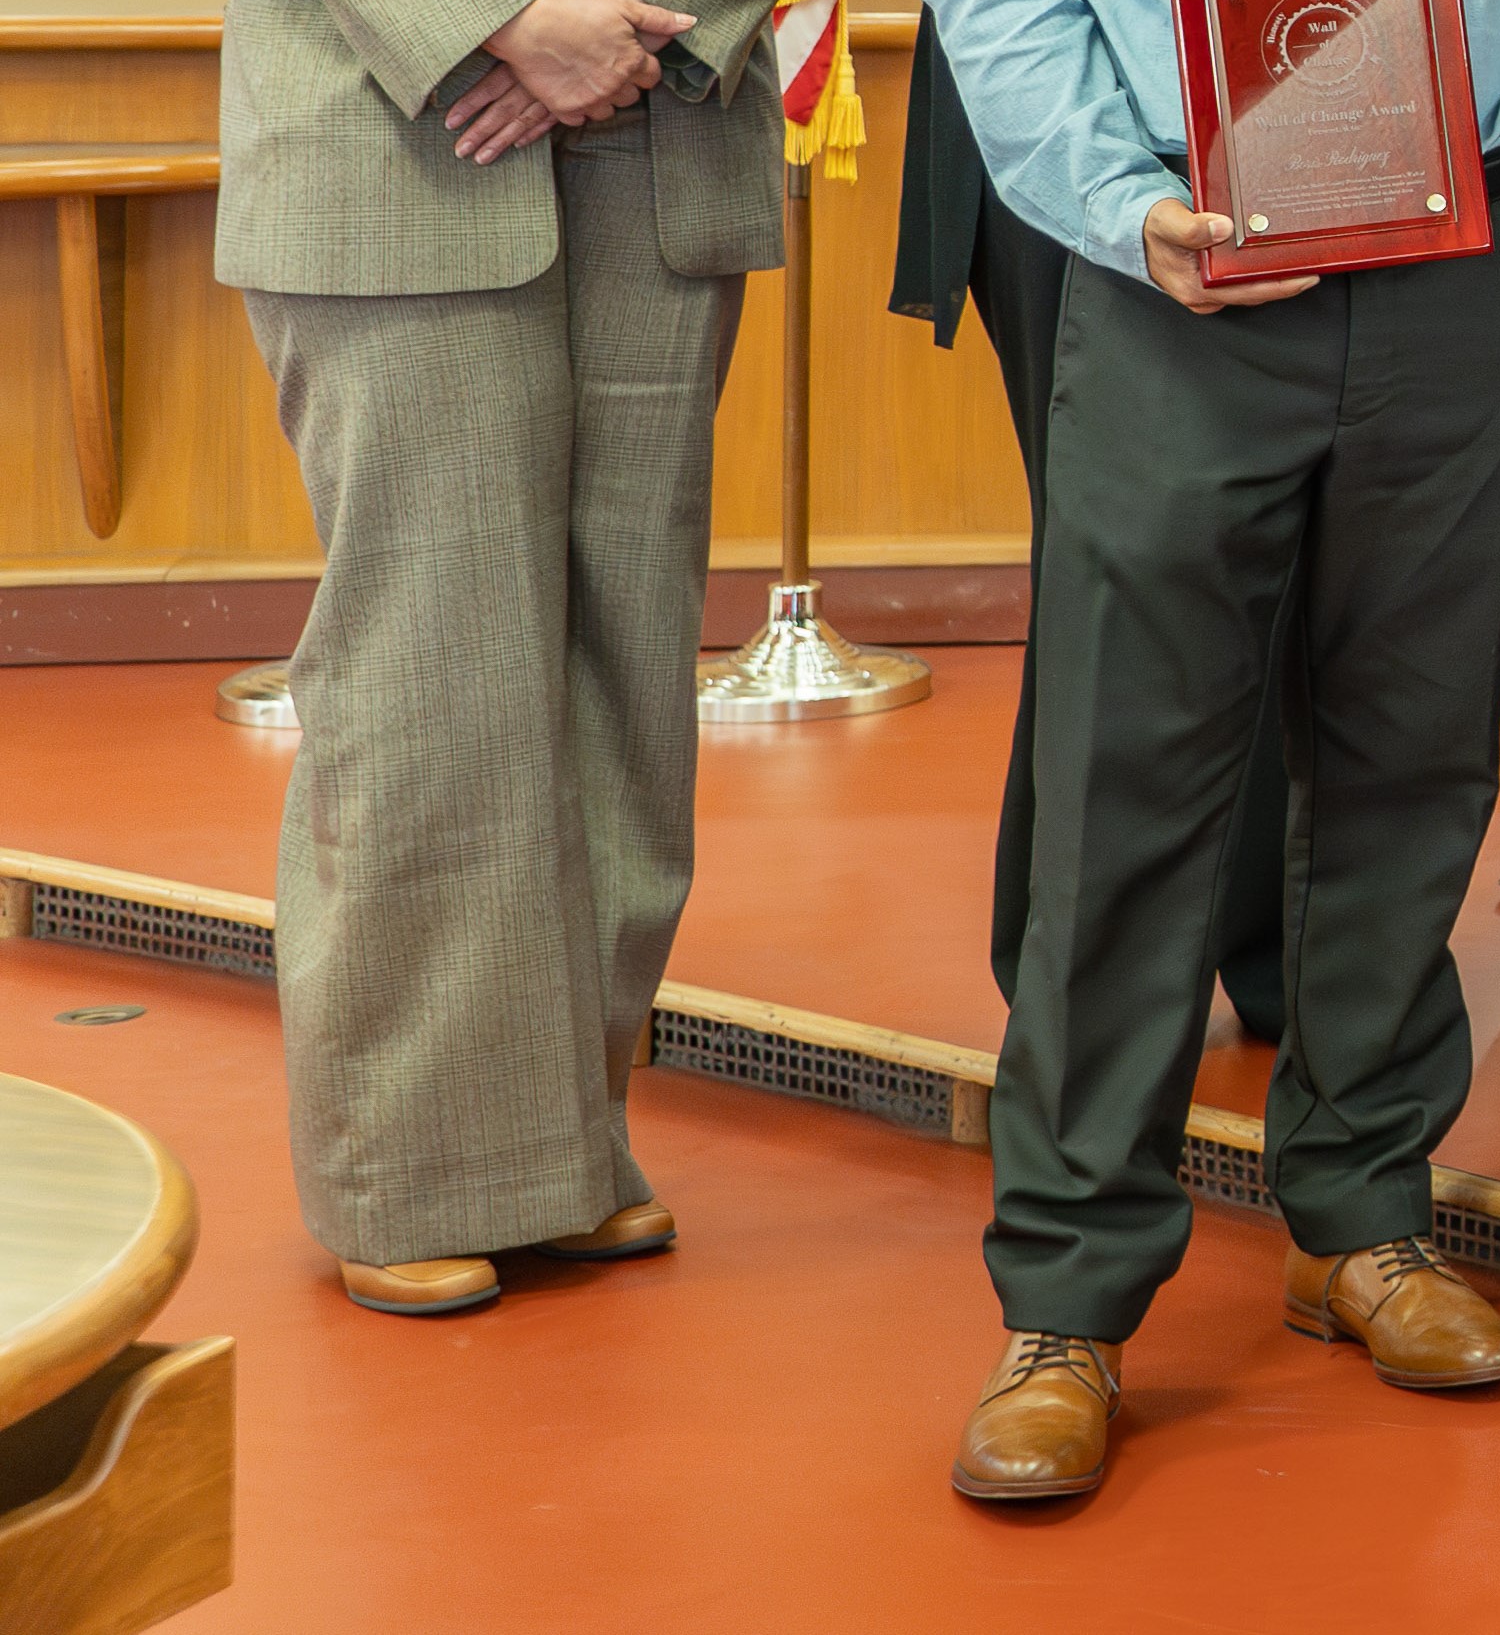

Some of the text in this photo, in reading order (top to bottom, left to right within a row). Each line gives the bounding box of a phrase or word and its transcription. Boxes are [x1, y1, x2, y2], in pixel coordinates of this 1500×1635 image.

[1266, 12, 1287, 44] Honesty
[1308, 20, 1337, 34] Wall
[1255, 100, 1418, 130] Wall of Change Award
